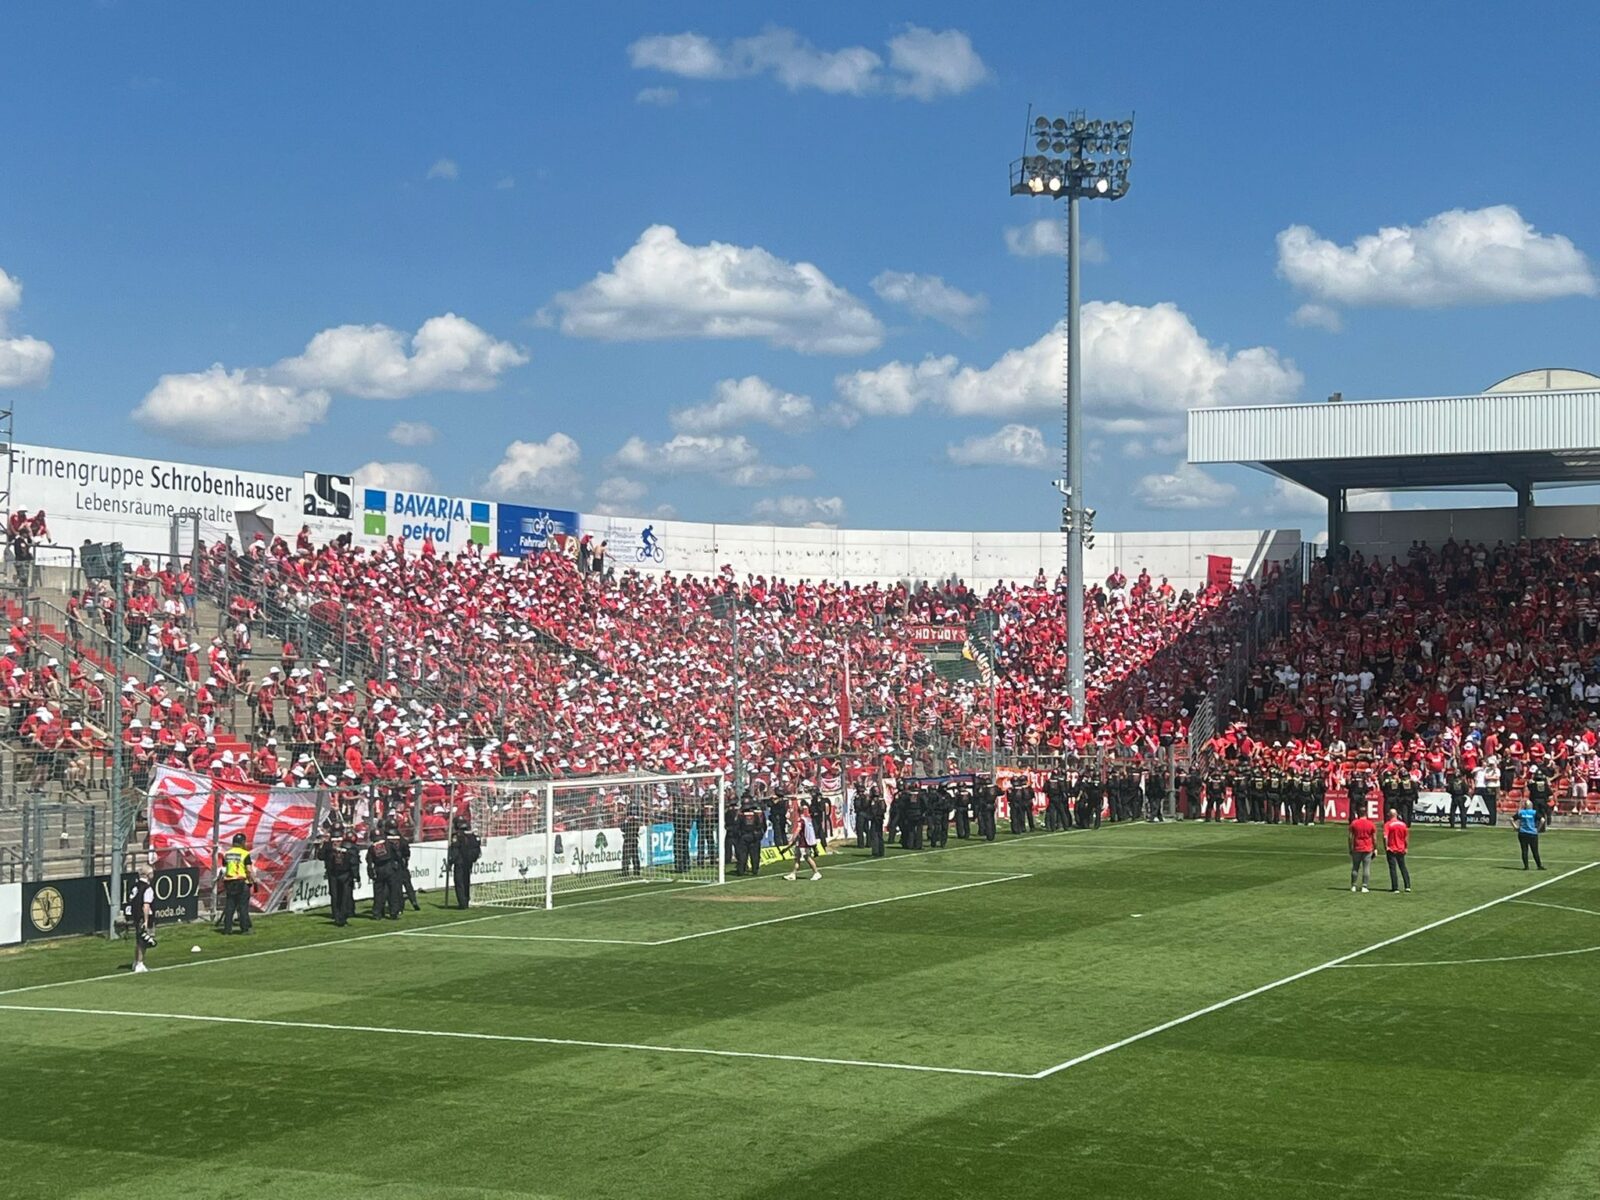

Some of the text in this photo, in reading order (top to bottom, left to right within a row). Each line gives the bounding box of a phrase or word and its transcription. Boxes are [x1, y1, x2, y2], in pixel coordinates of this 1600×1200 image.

[10, 450, 292, 502] Firmengruppe Schrobenhauser
[76, 491, 174, 518] Lebensräume
[394, 492, 465, 521] BAVARIA
[402, 520, 450, 542] petrol
